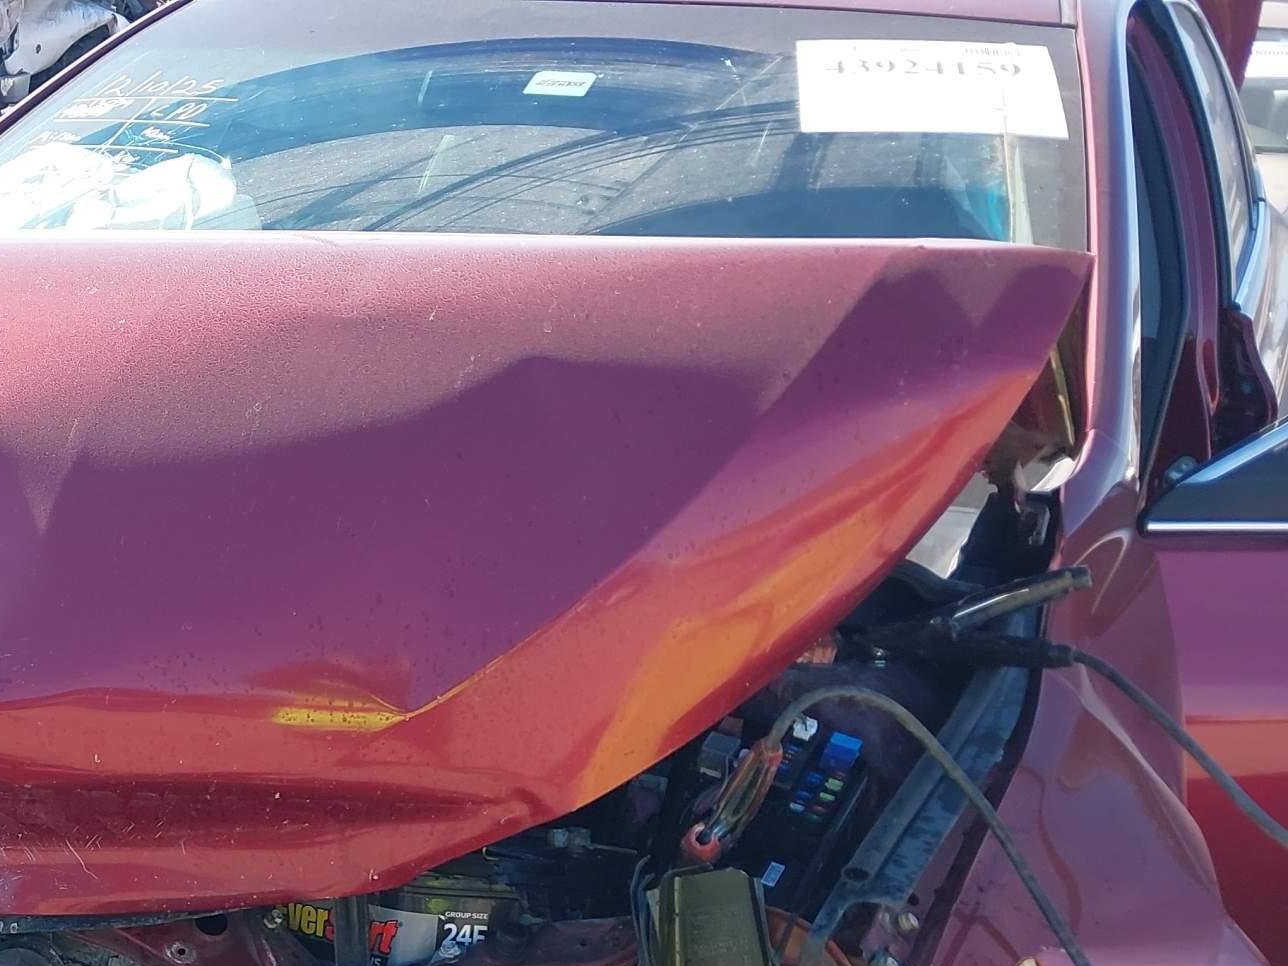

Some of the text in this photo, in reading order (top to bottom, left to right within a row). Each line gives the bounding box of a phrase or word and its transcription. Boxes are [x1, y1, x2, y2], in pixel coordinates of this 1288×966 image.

[825, 59, 1022, 75] 43924159
[444, 911, 489, 921] GROUP SIZE
